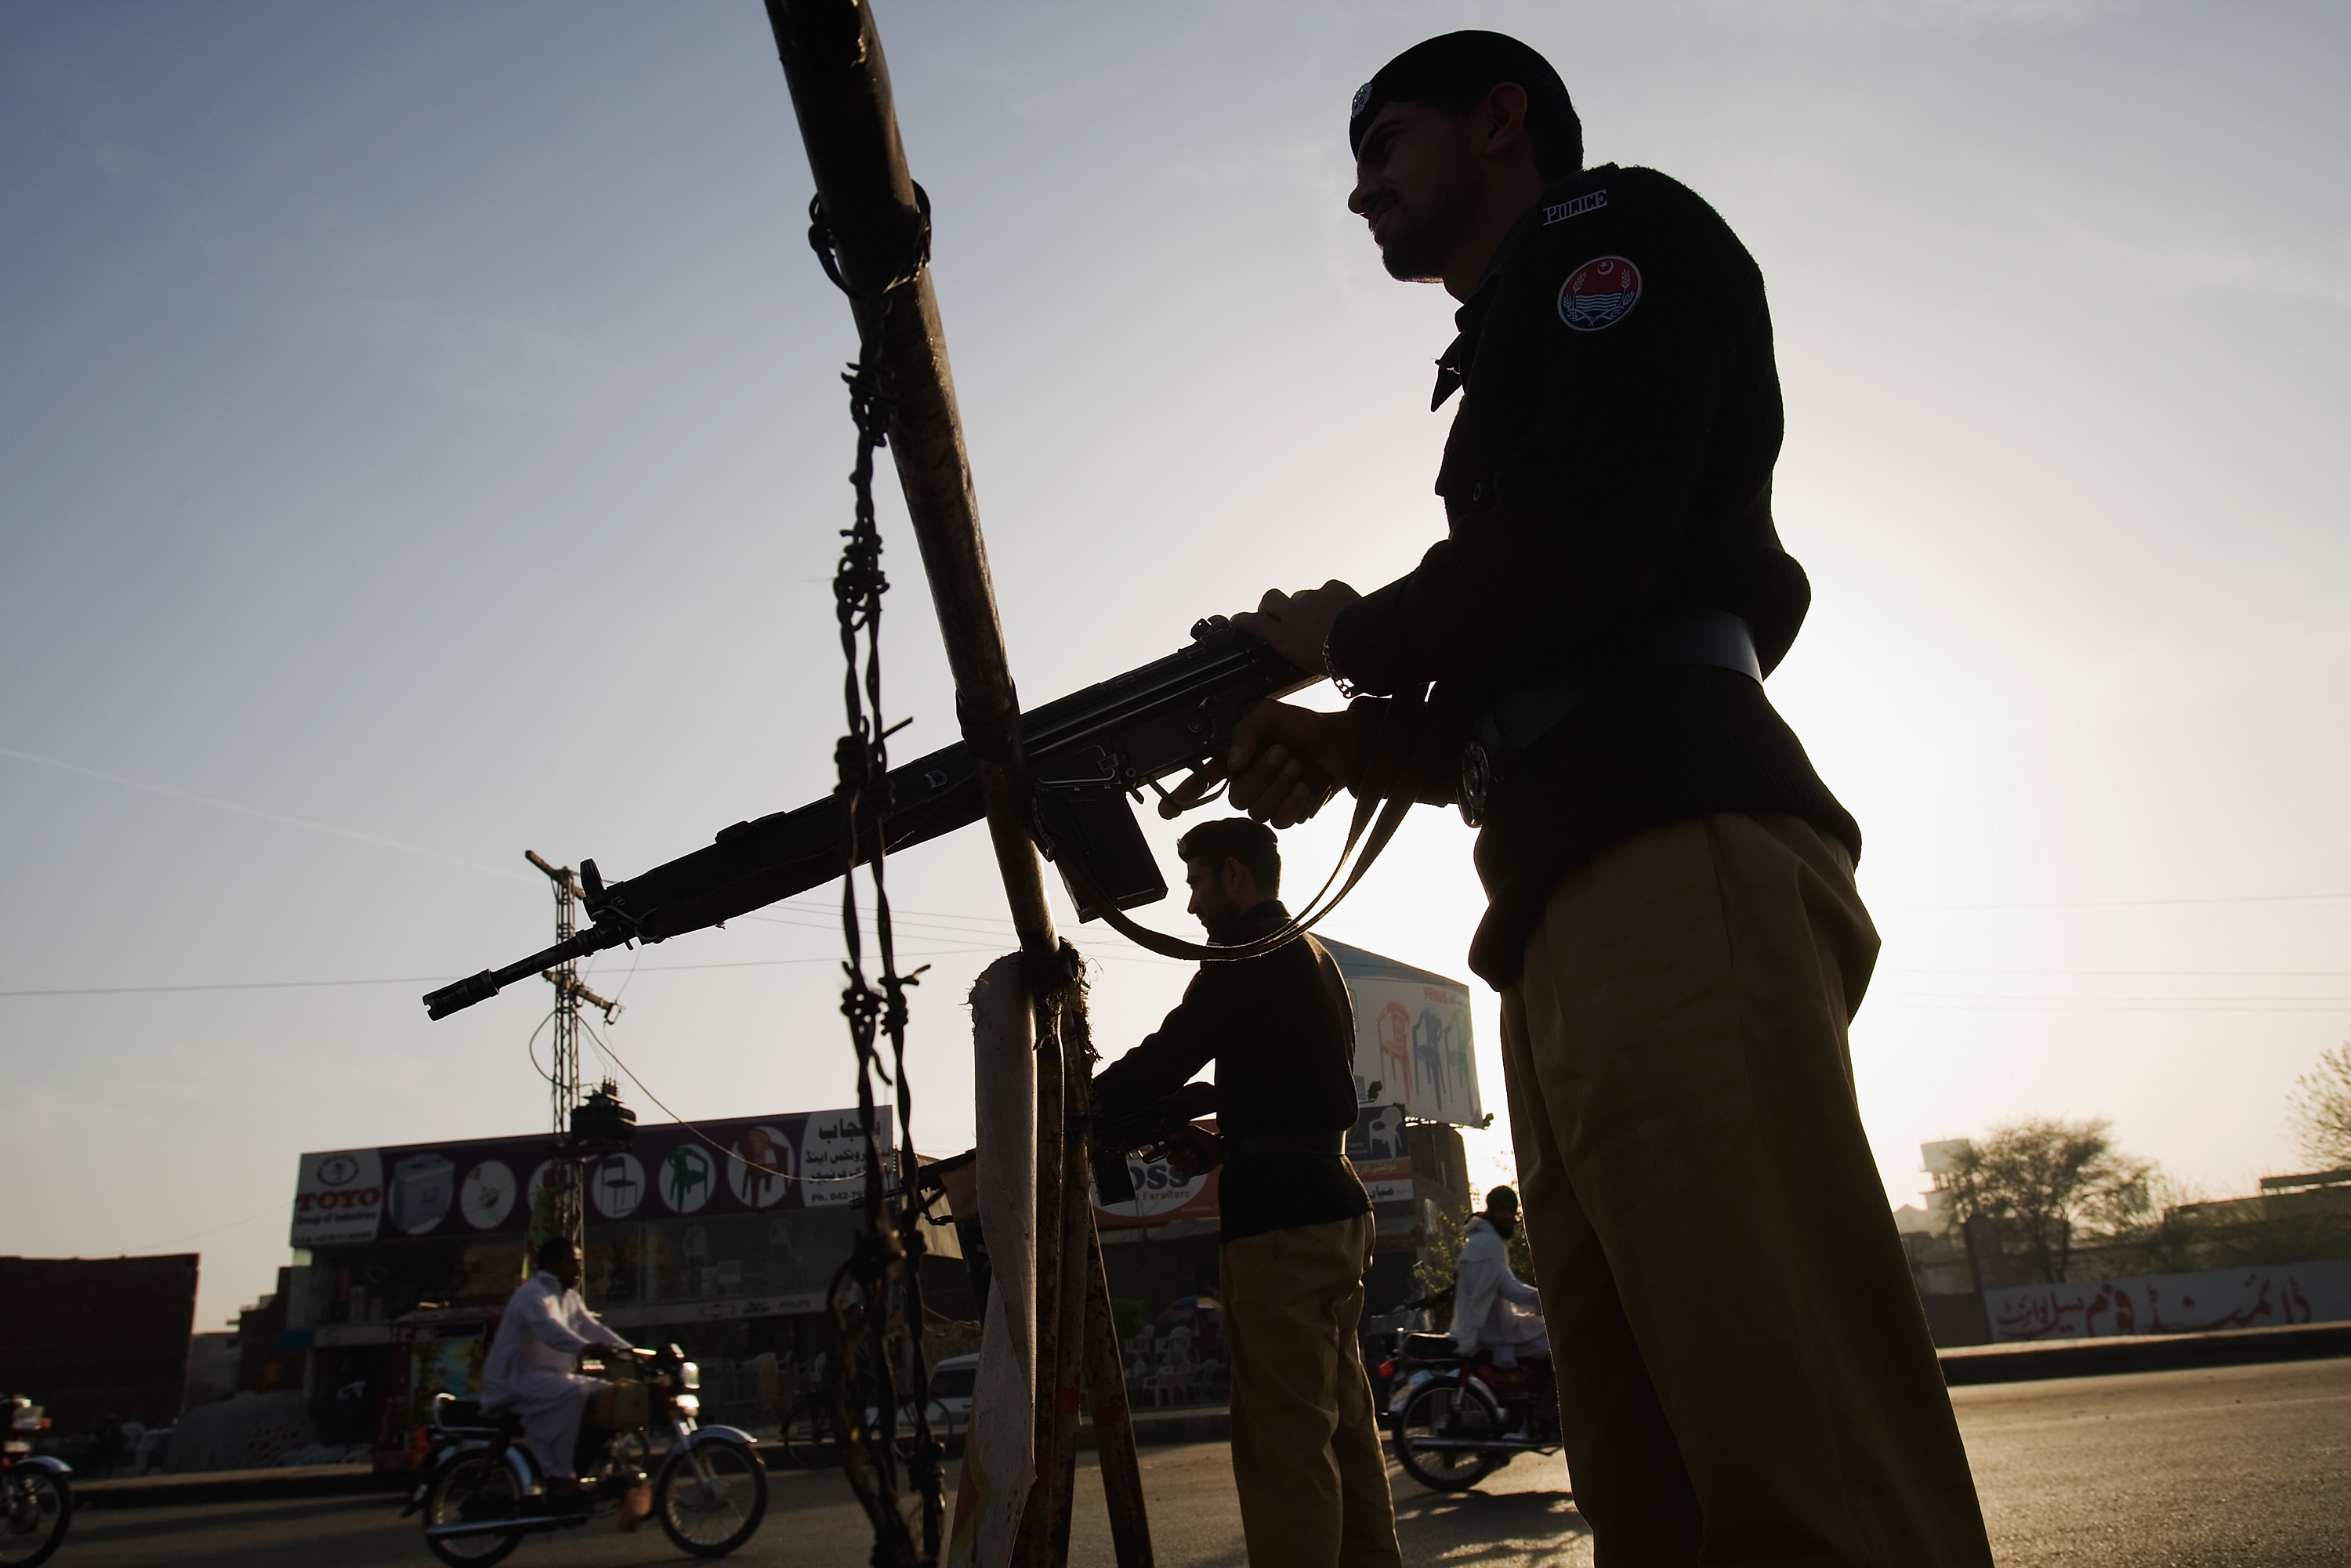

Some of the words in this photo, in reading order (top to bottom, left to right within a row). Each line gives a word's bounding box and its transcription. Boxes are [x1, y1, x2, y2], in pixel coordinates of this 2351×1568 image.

[1543, 189, 1607, 226] POLICE
[296, 1188, 380, 1211] TOYO
[1143, 1190, 1190, 1201] Furniture
